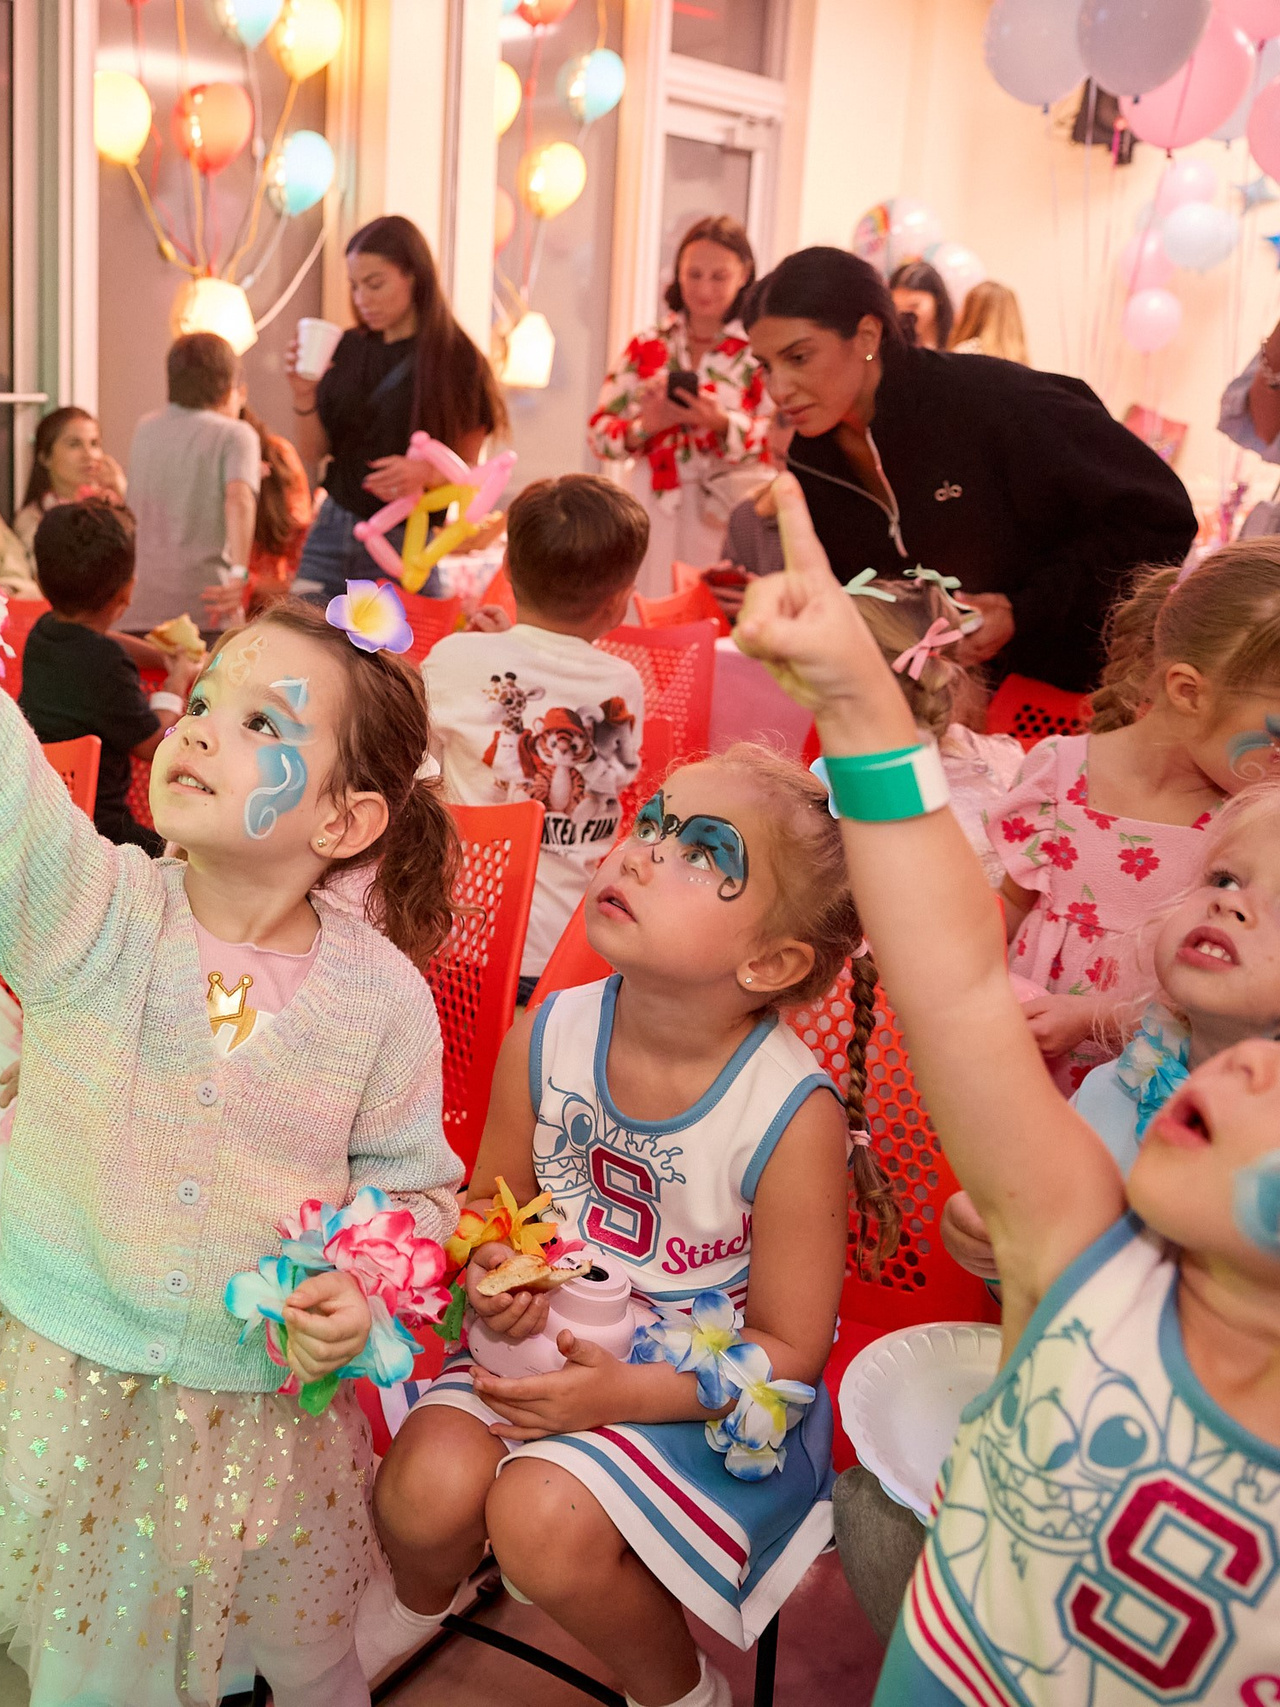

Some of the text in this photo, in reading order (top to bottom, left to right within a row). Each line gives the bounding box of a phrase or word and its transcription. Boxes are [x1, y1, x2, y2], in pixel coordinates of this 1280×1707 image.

[581, 817, 618, 844] FUN
[581, 1141, 659, 1263] S
[1063, 1470, 1271, 1698] S
